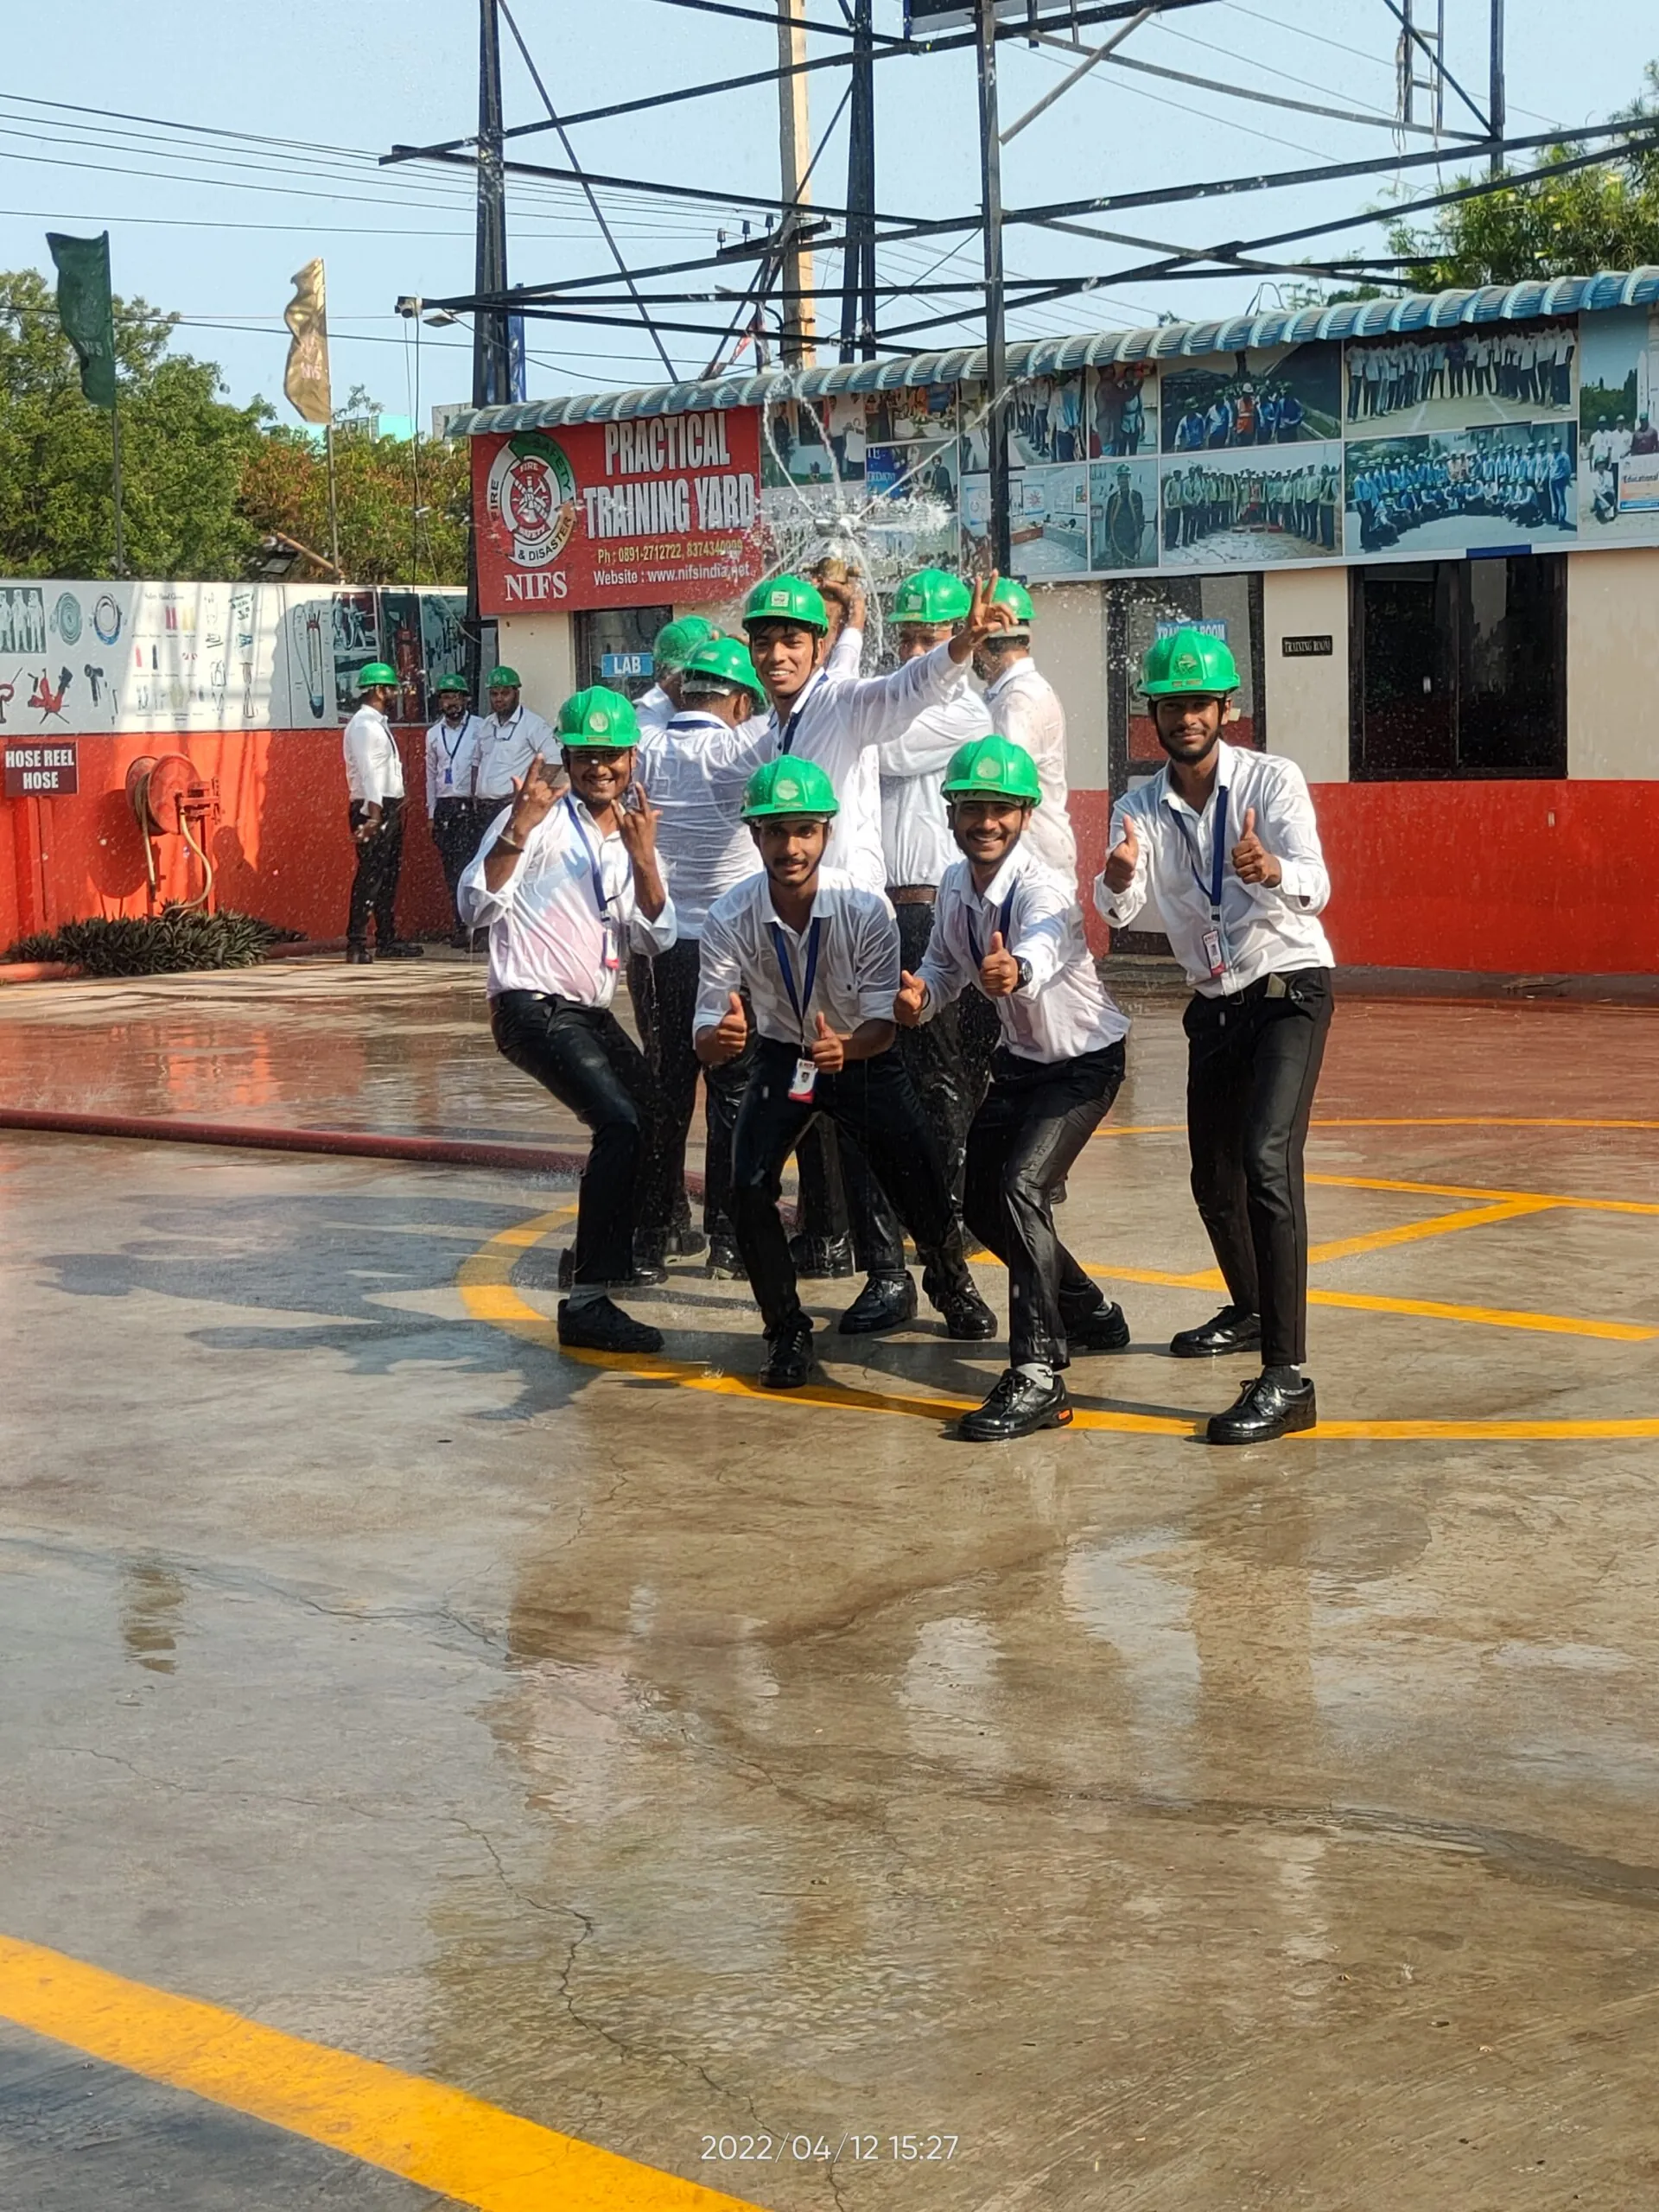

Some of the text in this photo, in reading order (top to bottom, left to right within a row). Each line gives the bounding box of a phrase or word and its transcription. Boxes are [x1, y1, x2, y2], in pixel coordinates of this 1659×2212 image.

[605, 411, 731, 475] PRACTICAL
[520, 462, 539, 473] FIRE
[490, 480, 499, 522] FIRE
[582, 474, 755, 539] TRAINING YARD
[518, 517, 572, 562] & DISASTER
[598, 549, 610, 564] Ph
[504, 570, 568, 601] NIFS
[594, 569, 638, 586] Website
[613, 656, 641, 675] LAB
[5, 749, 75, 768] HOSE REEL
[22, 771, 60, 790] HOSE
